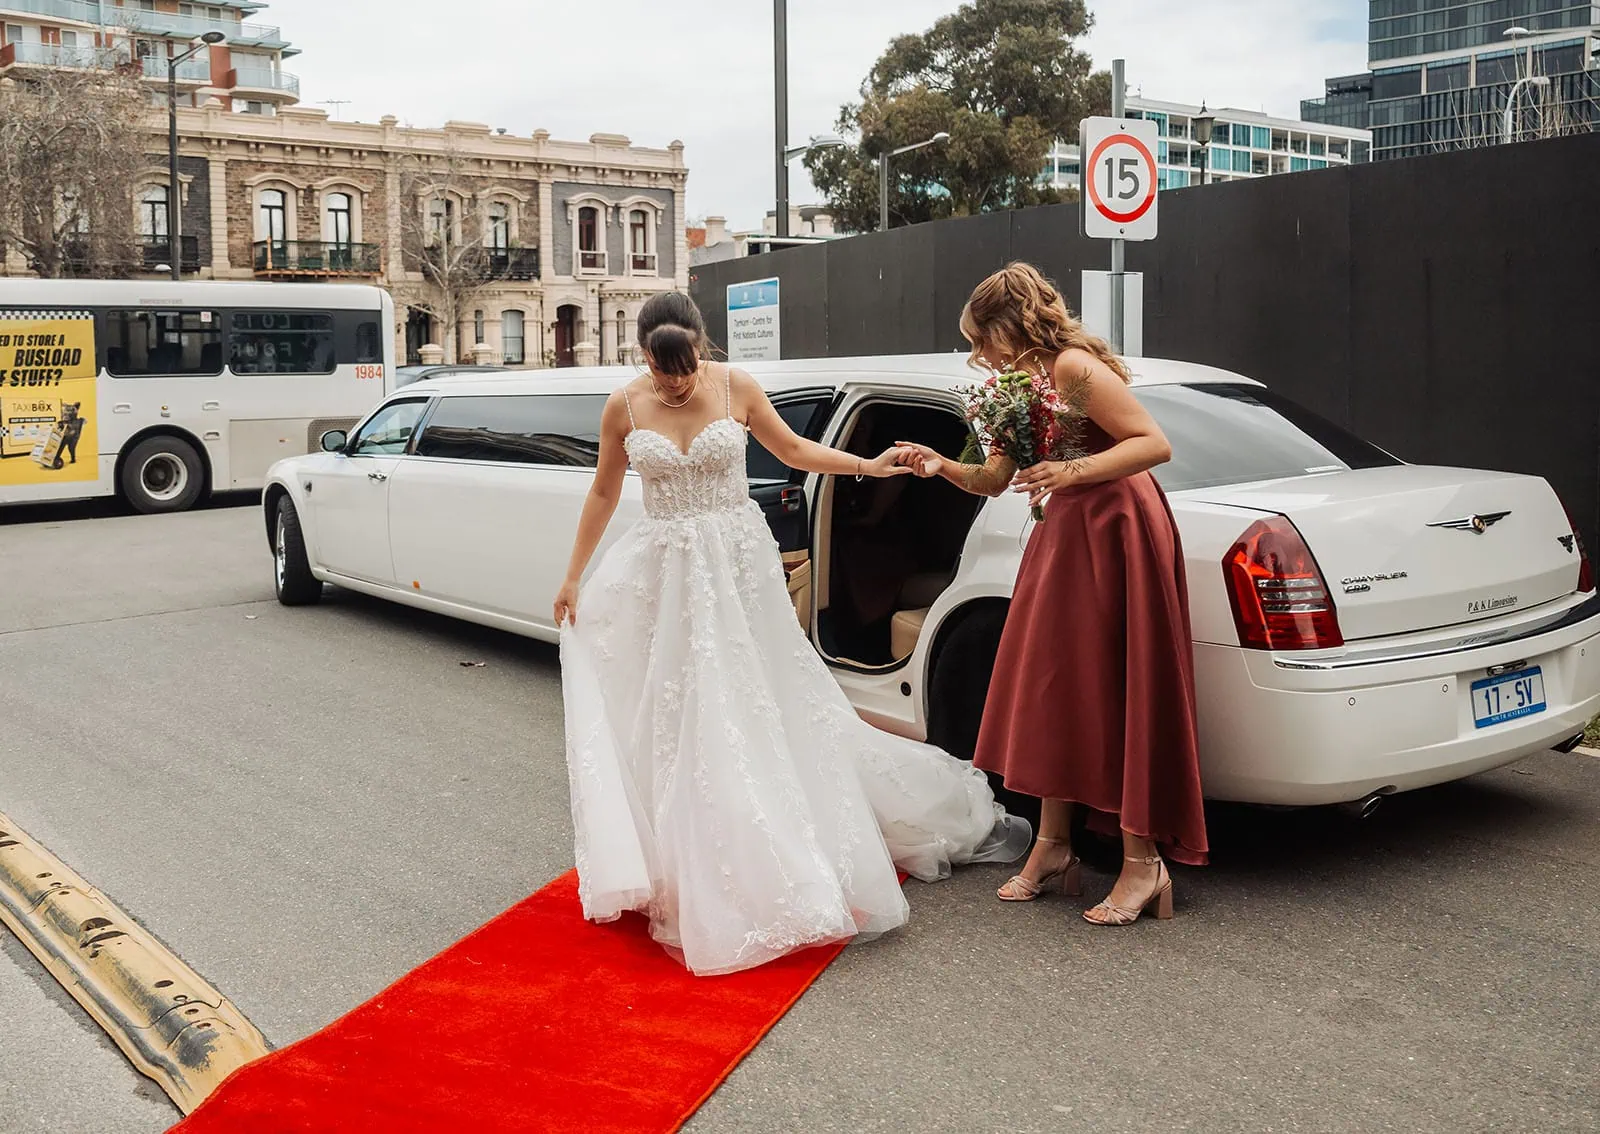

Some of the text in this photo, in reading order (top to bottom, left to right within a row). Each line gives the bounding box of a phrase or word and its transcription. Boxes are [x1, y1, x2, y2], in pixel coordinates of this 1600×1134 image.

[1104, 157, 1140, 200] 15
[13, 334, 25, 347] TO
[26, 334, 57, 347] STORE
[58, 334, 65, 346] A
[14, 348, 82, 367] BUSLOAD
[10, 369, 63, 387] STUFF?
[355, 364, 382, 379] 1984
[1341, 571, 1408, 584] CHRYSLER
[1468, 602, 1473, 612] P
[1487, 594, 1518, 608] Limousines
[1484, 686, 1500, 715] 17
[1515, 678, 1532, 707] SV
[1507, 707, 1531, 718] AUSTRALIA
